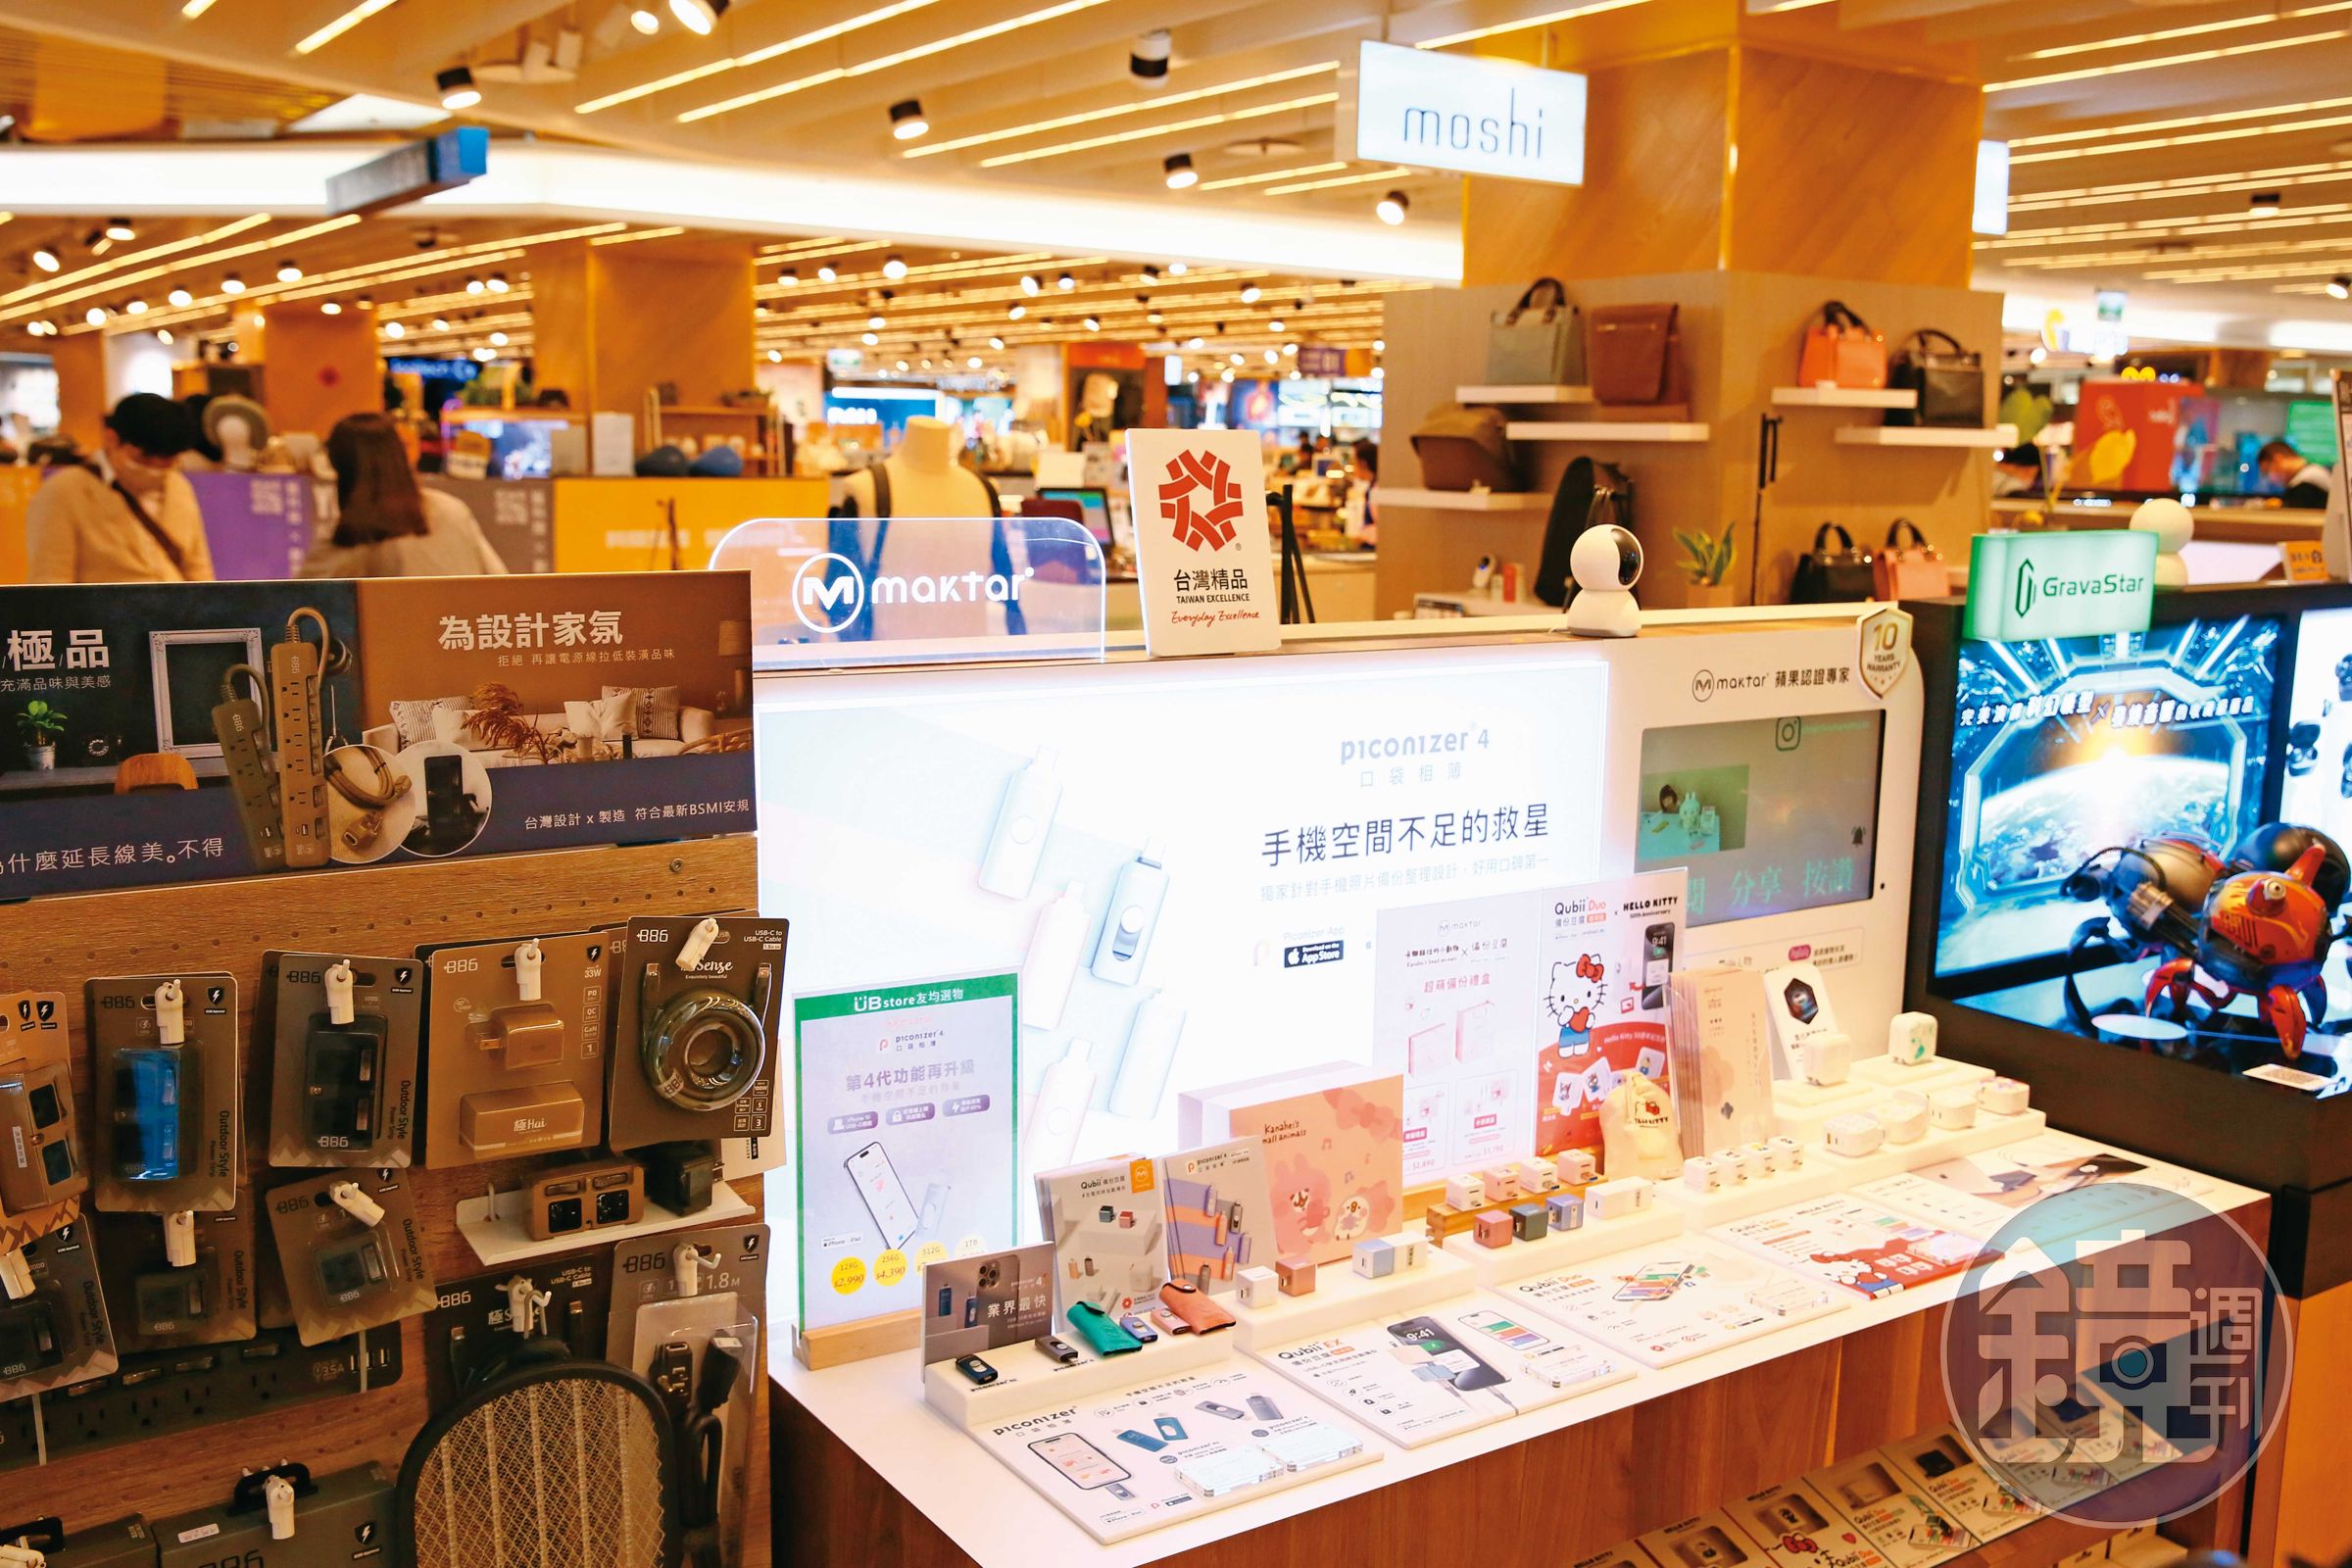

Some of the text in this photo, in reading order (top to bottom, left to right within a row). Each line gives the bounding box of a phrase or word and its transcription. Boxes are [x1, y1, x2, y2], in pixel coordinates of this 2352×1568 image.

[1403, 88, 1543, 158] moshi
[871, 570, 1028, 604] maktar
[1174, 568, 1248, 592] 台灣精品
[2043, 574, 2144, 596] GravaStar
[1177, 593, 1250, 604] TAIWAN EXCELLENCE
[1171, 610, 1259, 627] Everyday Excellence
[438, 611, 623, 651] 為設計家氛
[1873, 623, 1898, 651] 10
[498, 648, 675, 666] 拒絕 再讓電源線拉低裝潢品味
[1866, 662, 1901, 673] WARRANTY
[1874, 654, 1895, 662] YEARS
[1716, 676, 1766, 690] maktar
[1775, 667, 1850, 688] 蘋果認證專家
[1478, 729, 1490, 749] 4
[525, 812, 581, 830] 台灣設計
[599, 809, 626, 824] 製造
[635, 799, 750, 820] 符合最新BSMI安規
[1262, 804, 1549, 867] 手機空間不足的救星
[1554, 896, 1678, 915] Qubii Duo HELLO KITTY
[681, 959, 733, 974] Sense
[1301, 951, 1340, 963] App Store
[847, 1059, 974, 1092] 第4代功能再升級
[399, 1080, 412, 1140] Outdoor Style
[220, 1110, 229, 1178] Outdoor Style
[1081, 1178, 1102, 1190] Qubii
[403, 1218, 424, 1280] Outdoor Style
[988, 1295, 1047, 1318] 業界最快
[1406, 1328, 1436, 1343] 9:41
[1278, 1343, 1323, 1360] Qubii
[1323, 1338, 1344, 1349] EX
[993, 1408, 1076, 1436] piconizer
